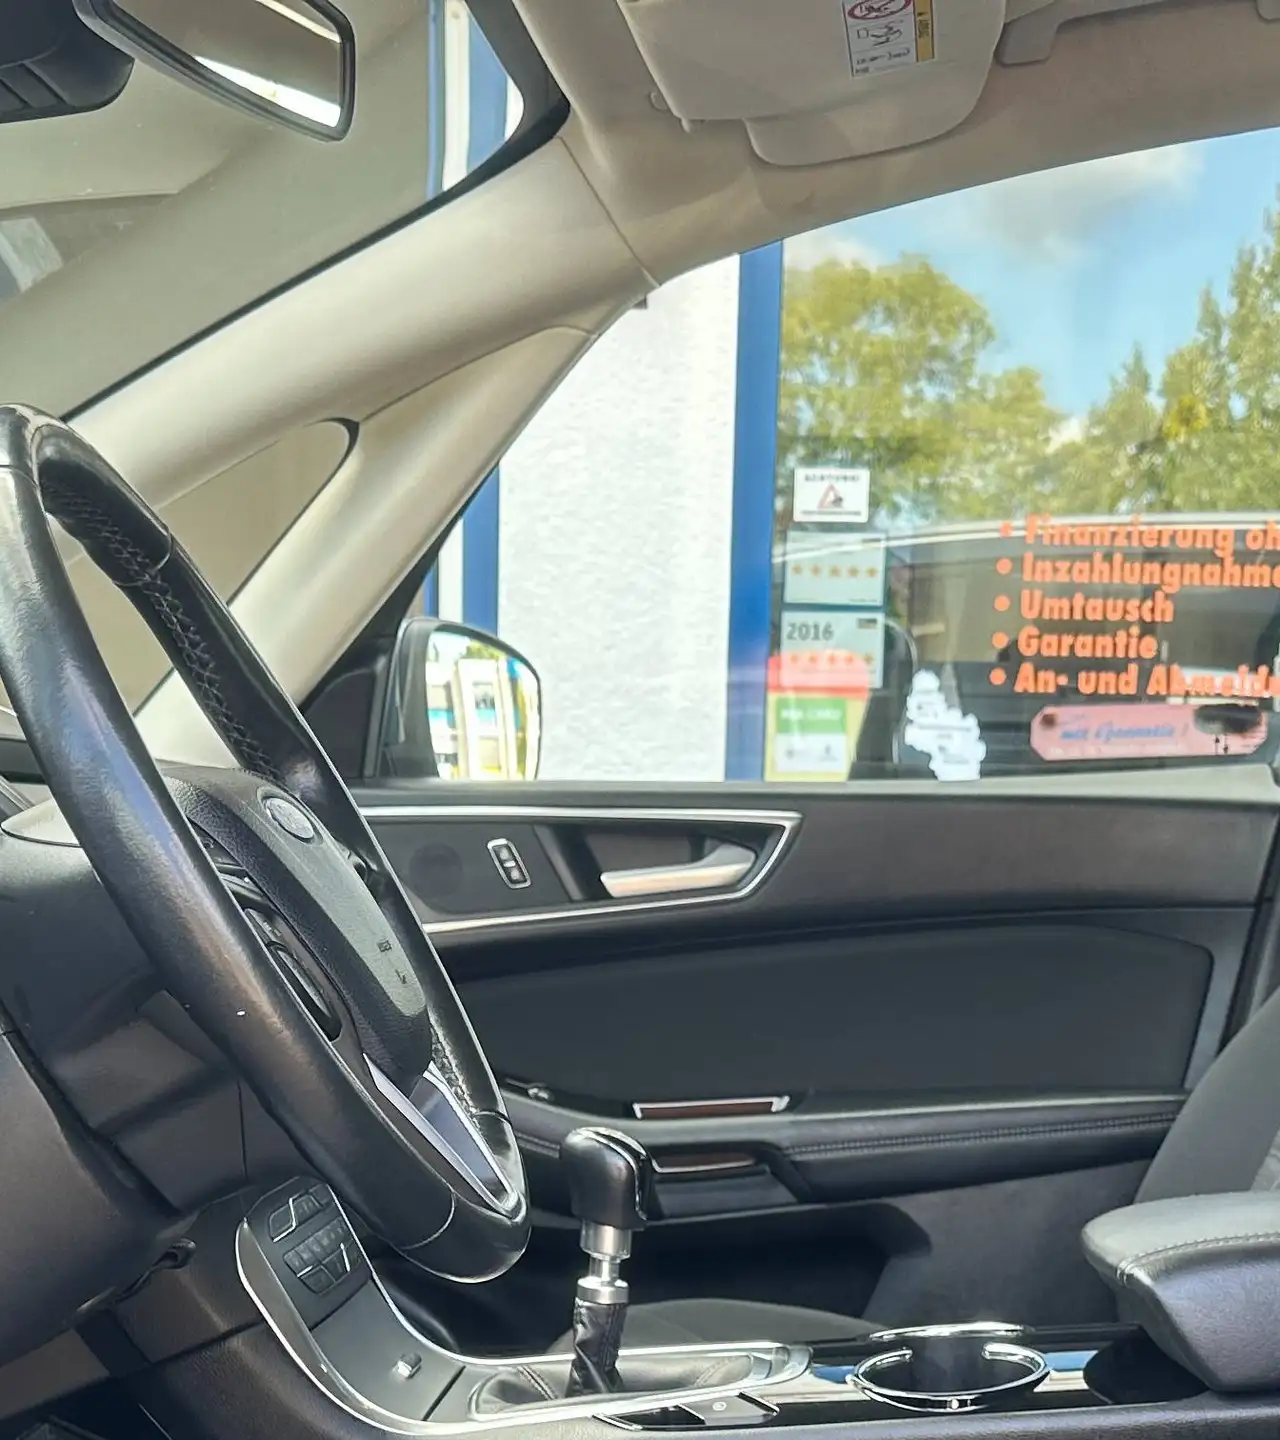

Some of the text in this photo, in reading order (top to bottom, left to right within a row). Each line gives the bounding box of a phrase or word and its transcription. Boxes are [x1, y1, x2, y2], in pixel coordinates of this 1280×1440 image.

[1024, 514, 1235, 557] Finanzierung
[1020, 588, 1175, 623] Umtausch
[786, 621, 835, 641] 2016
[1017, 624, 1159, 659] Garantie
[1013, 662, 1069, 695] An-
[1078, 662, 1139, 695] und
